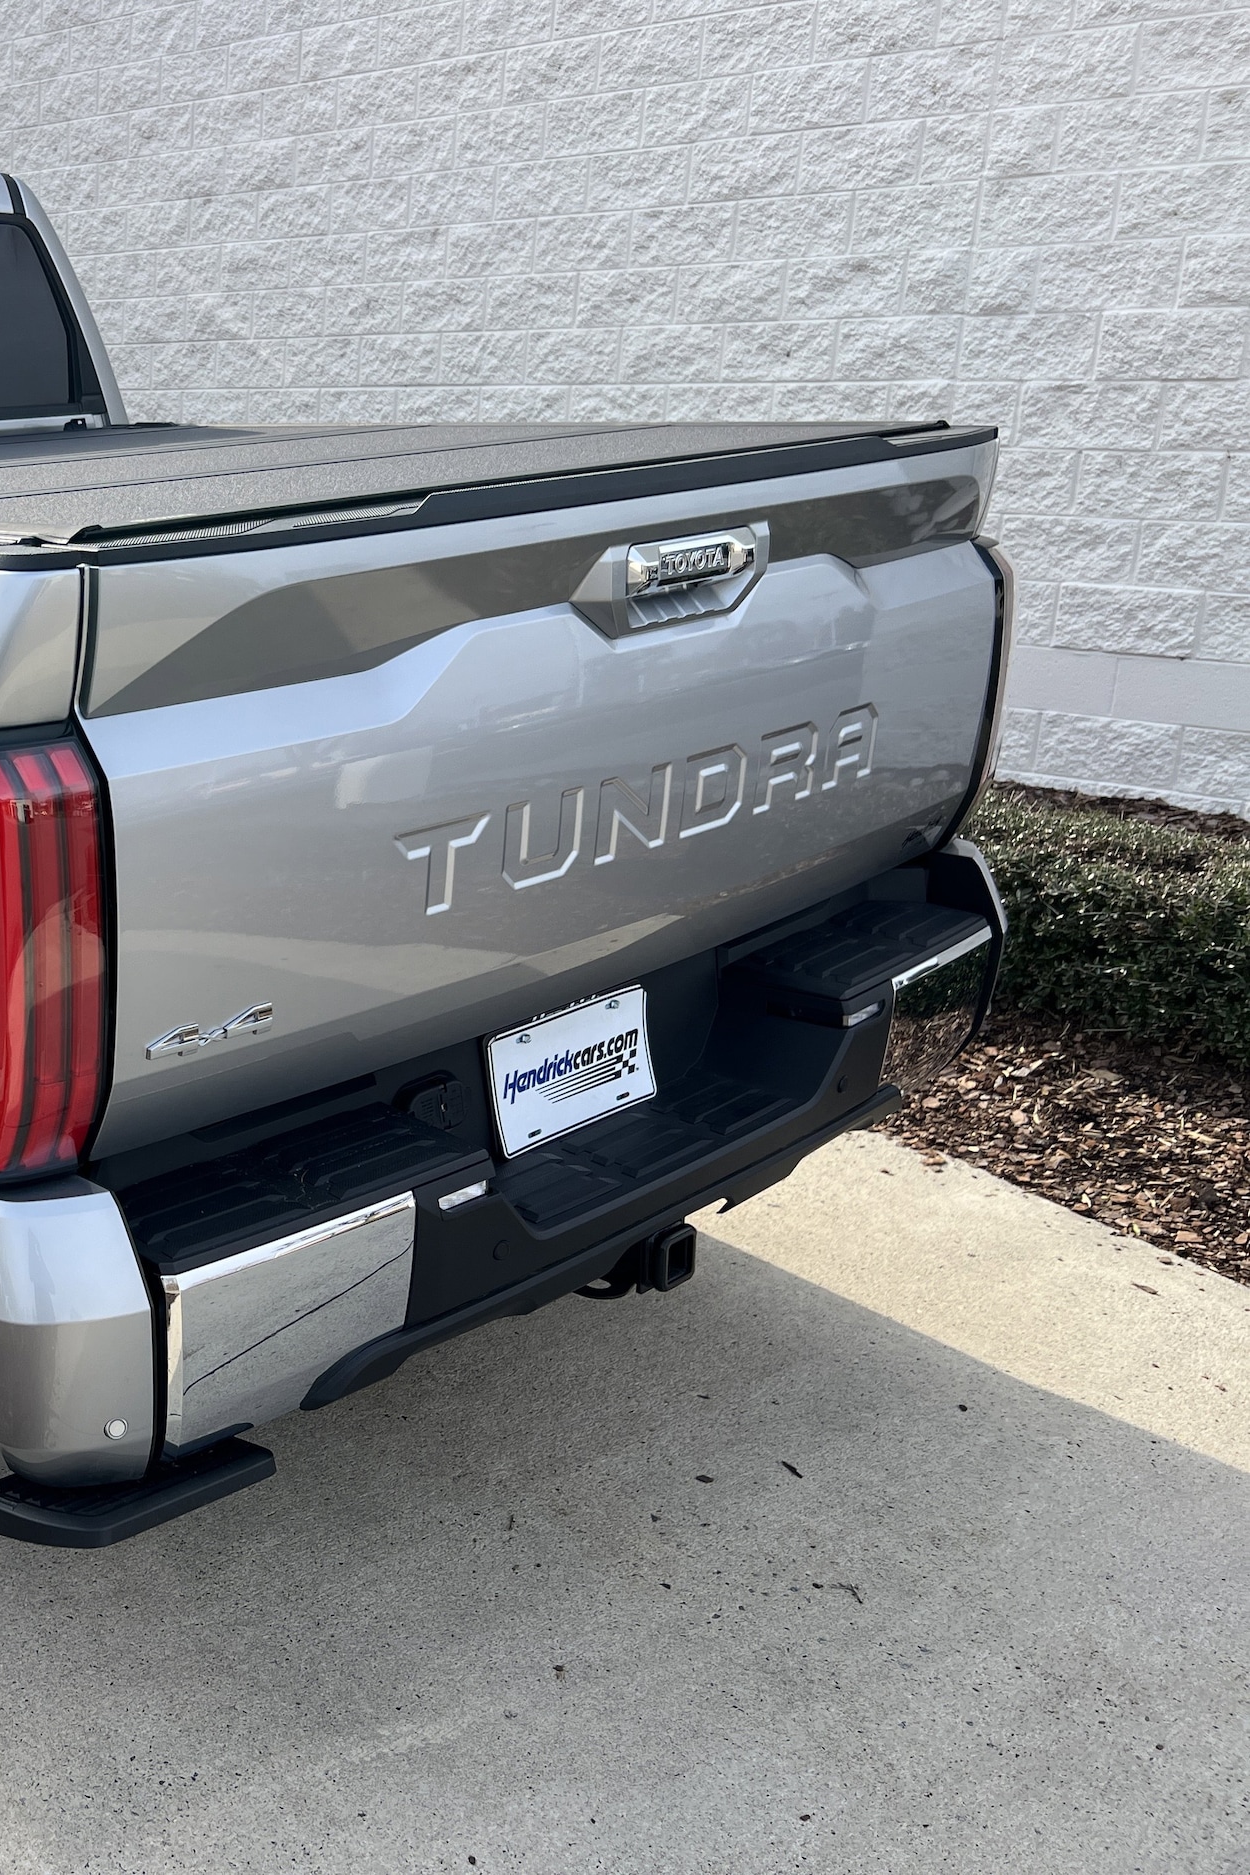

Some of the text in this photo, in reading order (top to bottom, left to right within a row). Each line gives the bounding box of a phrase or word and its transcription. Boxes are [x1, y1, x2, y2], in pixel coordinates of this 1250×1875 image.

[665, 546, 724, 575] TOYOTA
[394, 702, 879, 916] TUNDRA
[503, 1028, 639, 1104] Hendrickcars.com
